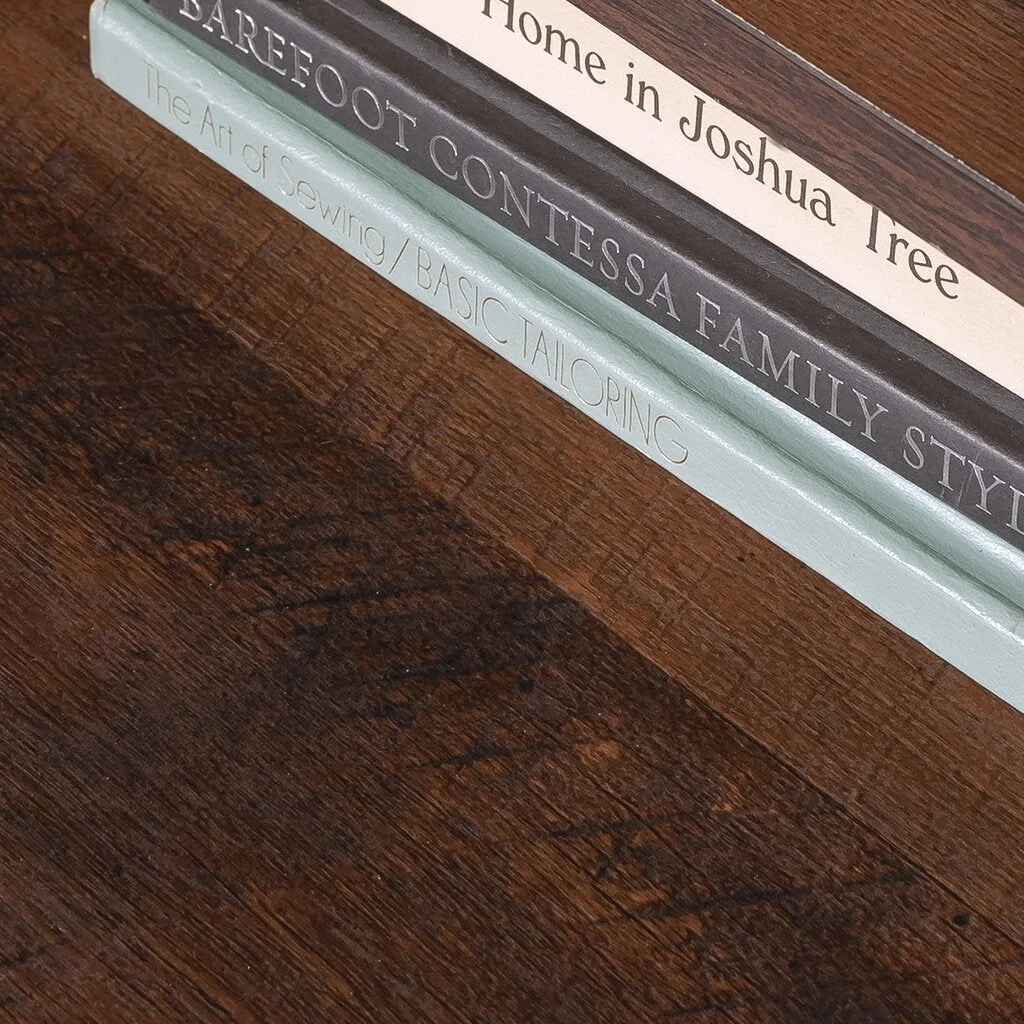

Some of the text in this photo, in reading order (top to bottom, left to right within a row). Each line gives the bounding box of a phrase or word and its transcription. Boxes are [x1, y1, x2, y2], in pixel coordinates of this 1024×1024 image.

[142, 59, 192, 125] The
[200, 104, 233, 156] Art
[242, 144, 269, 179] of
[278, 154, 386, 267] Sewing
[415, 245, 509, 344] BASIC
[518, 314, 689, 465] TAILORING
[429, 134, 682, 322] CONTESSA
[695, 291, 889, 443] FAMILY
[624, 61, 662, 122] in
[679, 95, 836, 227] Joshua
[866, 206, 960, 300] Tree
